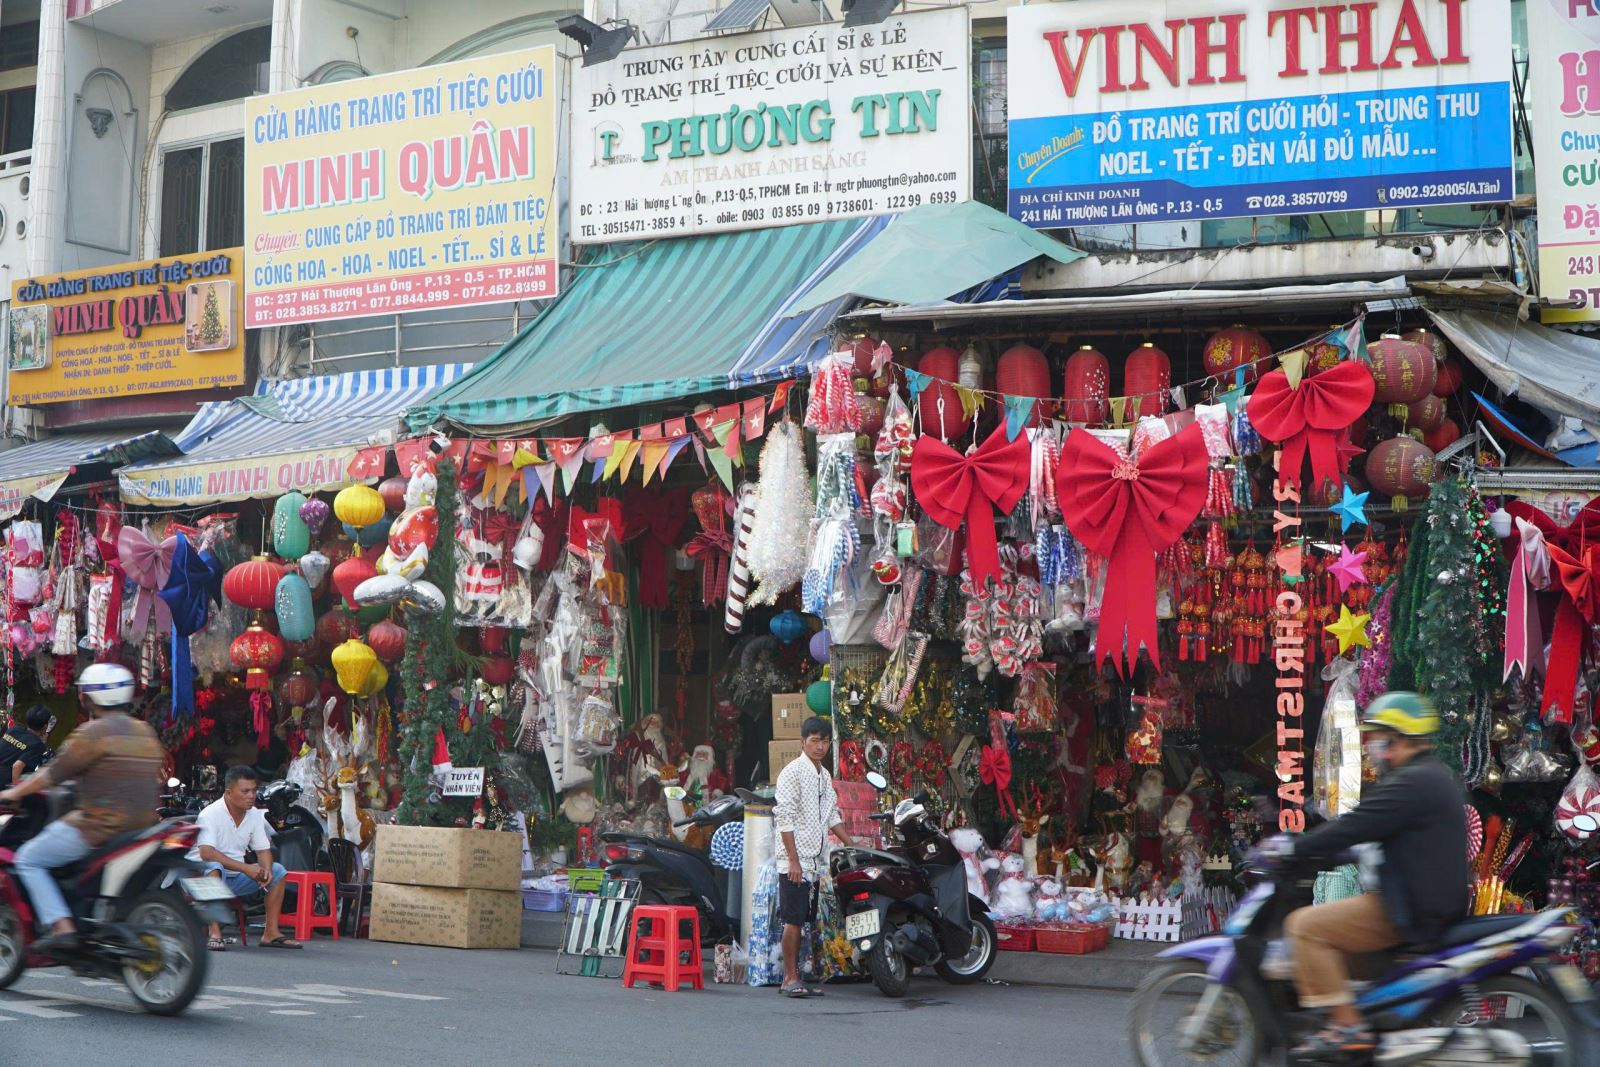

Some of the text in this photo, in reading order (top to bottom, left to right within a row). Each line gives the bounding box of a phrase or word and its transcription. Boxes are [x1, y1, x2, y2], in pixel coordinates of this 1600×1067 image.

[623, 22, 907, 78] TRUNG TÂM CUNG SỈ & LẺ
[1043, 14, 1247, 97] VINH
[590, 49, 943, 110] ĐỒ TRANG TRÍ TIỆC CƯỚI VÀ SỰ KIỆN
[254, 63, 543, 144] CỬA HÀNG TRANG TRÍ TIỆC CƯỚI
[1093, 92, 1479, 144] ĐỒ TRANG TRÍ CƯỚI HỎI TRUNG THU
[641, 89, 942, 163] PHƯƠNG TIN
[262, 120, 532, 214] MINH QUÂN
[694, 161, 761, 182] THANH
[767, 154, 808, 177] ÁNH
[812, 148, 866, 172] SÁNG
[1017, 127, 1085, 171] Chuyên Doanh:
[1100, 152, 1152, 176] NOEL
[1173, 140, 1213, 171] TẾT
[1232, 139, 1274, 167] ĐÈN
[1283, 132, 1315, 163] VẢI
[1324, 130, 1353, 161] ĐỦ
[1390, 180, 1500, 199] 0902.928005(A.Tân)
[1563, 159, 1600, 187] CƯ
[625, 198, 638, 211] Hải
[645, 198, 669, 213] hượng
[758, 184, 790, 198] TPHCM
[717, 211, 738, 223] obile:
[1020, 189, 1140, 204] ĐỊA CHỈ KINH DOANH
[1021, 211, 1040, 223] 241
[1043, 207, 1061, 221] HẢI
[1066, 203, 1107, 220] THƯỢNG
[1111, 201, 1132, 217] LÃN
[1136, 199, 1158, 215] ÔNG
[1203, 199, 1223, 212] Q.5
[1264, 191, 1347, 208] 028.38570799
[254, 195, 545, 254] Chuyên: CUNG CẤP ĐỒ TRANG TRÍ ĐÁM TIỆC
[17, 255, 228, 301] CỬA HÀNG TRANG TRÍ TIỆC CƯỚI
[254, 256, 292, 287] CỔNG
[298, 260, 326, 280] HOA
[342, 253, 372, 276] HOA
[388, 247, 426, 270] NOEL
[511, 235, 522, 256] &
[527, 230, 546, 255] LẺ
[1568, 256, 1593, 275] 243
[254, 264, 546, 306] ĐC: 237 Hải Thượng Lãn Ông P.13 Q.5 TP.HCM
[254, 280, 546, 321] ĐT: 028.3853.8271 077.8844.999 077.462.8899
[53, 285, 186, 338] MINH QUÂN
[76, 348, 88, 356] CUNG
[80, 357, 93, 366] HOA
[98, 356, 112, 364] HOA
[94, 367, 111, 376] DANH
[147, 473, 170, 497] CỬA
[175, 471, 202, 497] HÀNG
[206, 465, 269, 496] MINH
[277, 455, 343, 494] QUÂN
